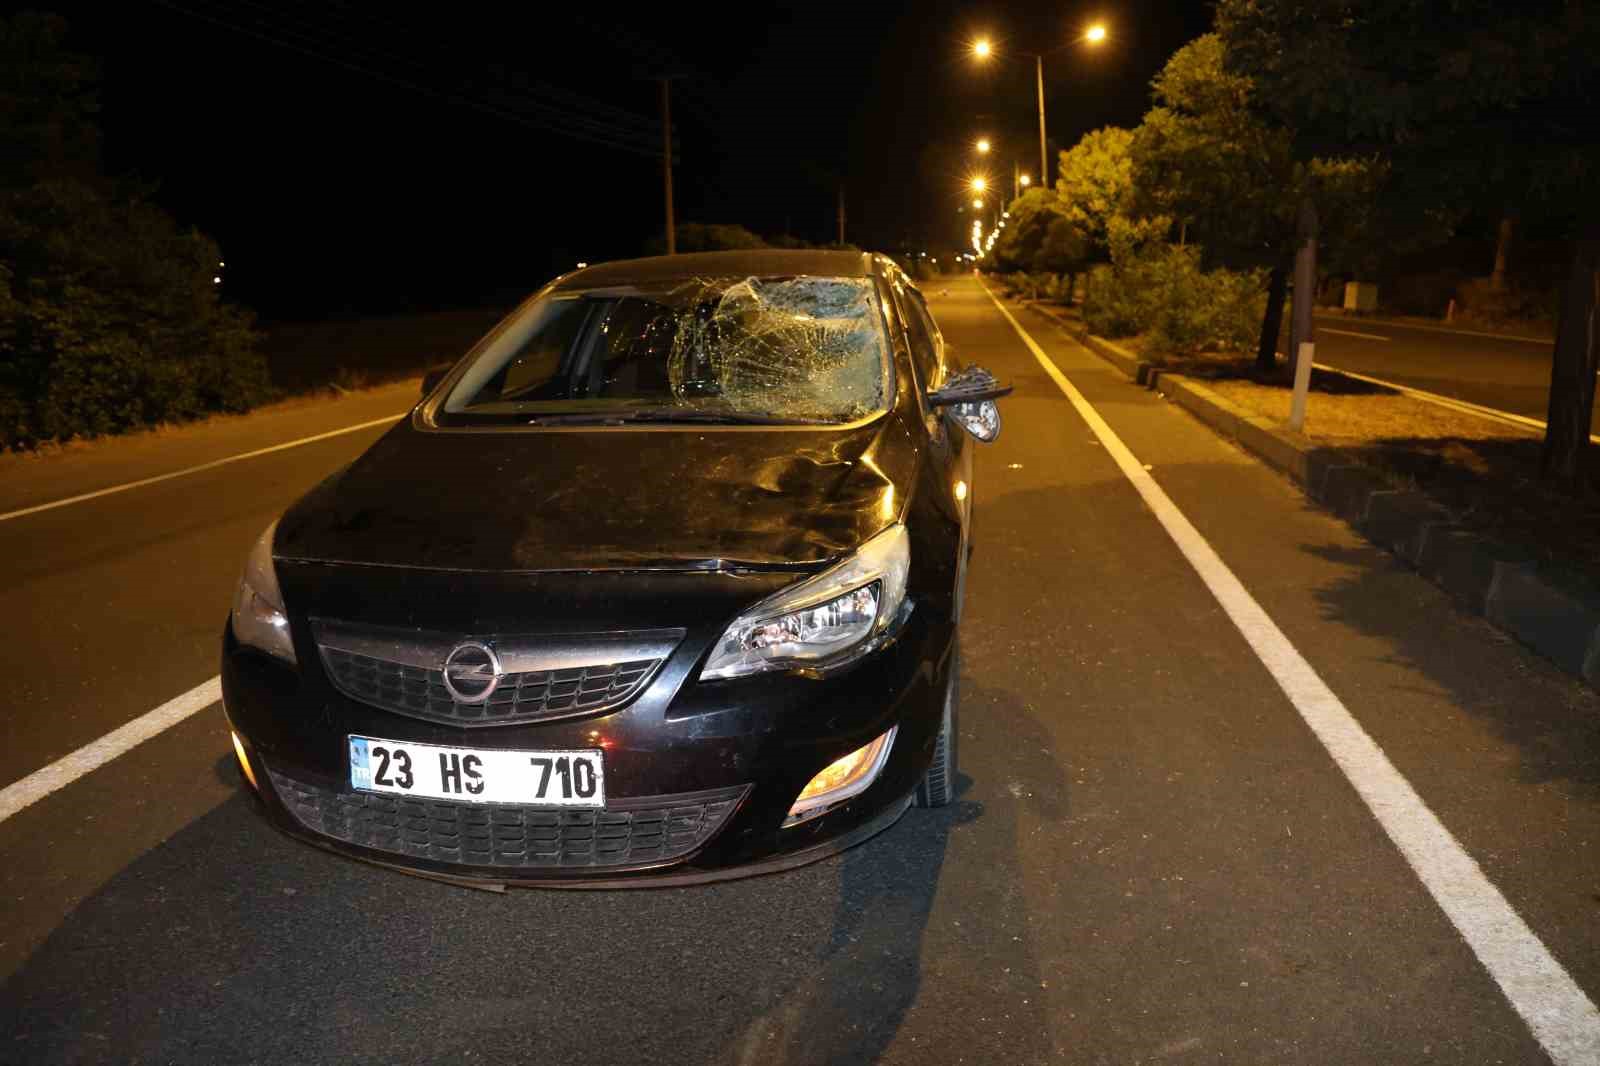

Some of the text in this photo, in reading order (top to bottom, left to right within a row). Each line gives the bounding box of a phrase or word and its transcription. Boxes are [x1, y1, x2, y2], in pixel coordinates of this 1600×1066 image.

[372, 747, 596, 799] 23 HS 710
